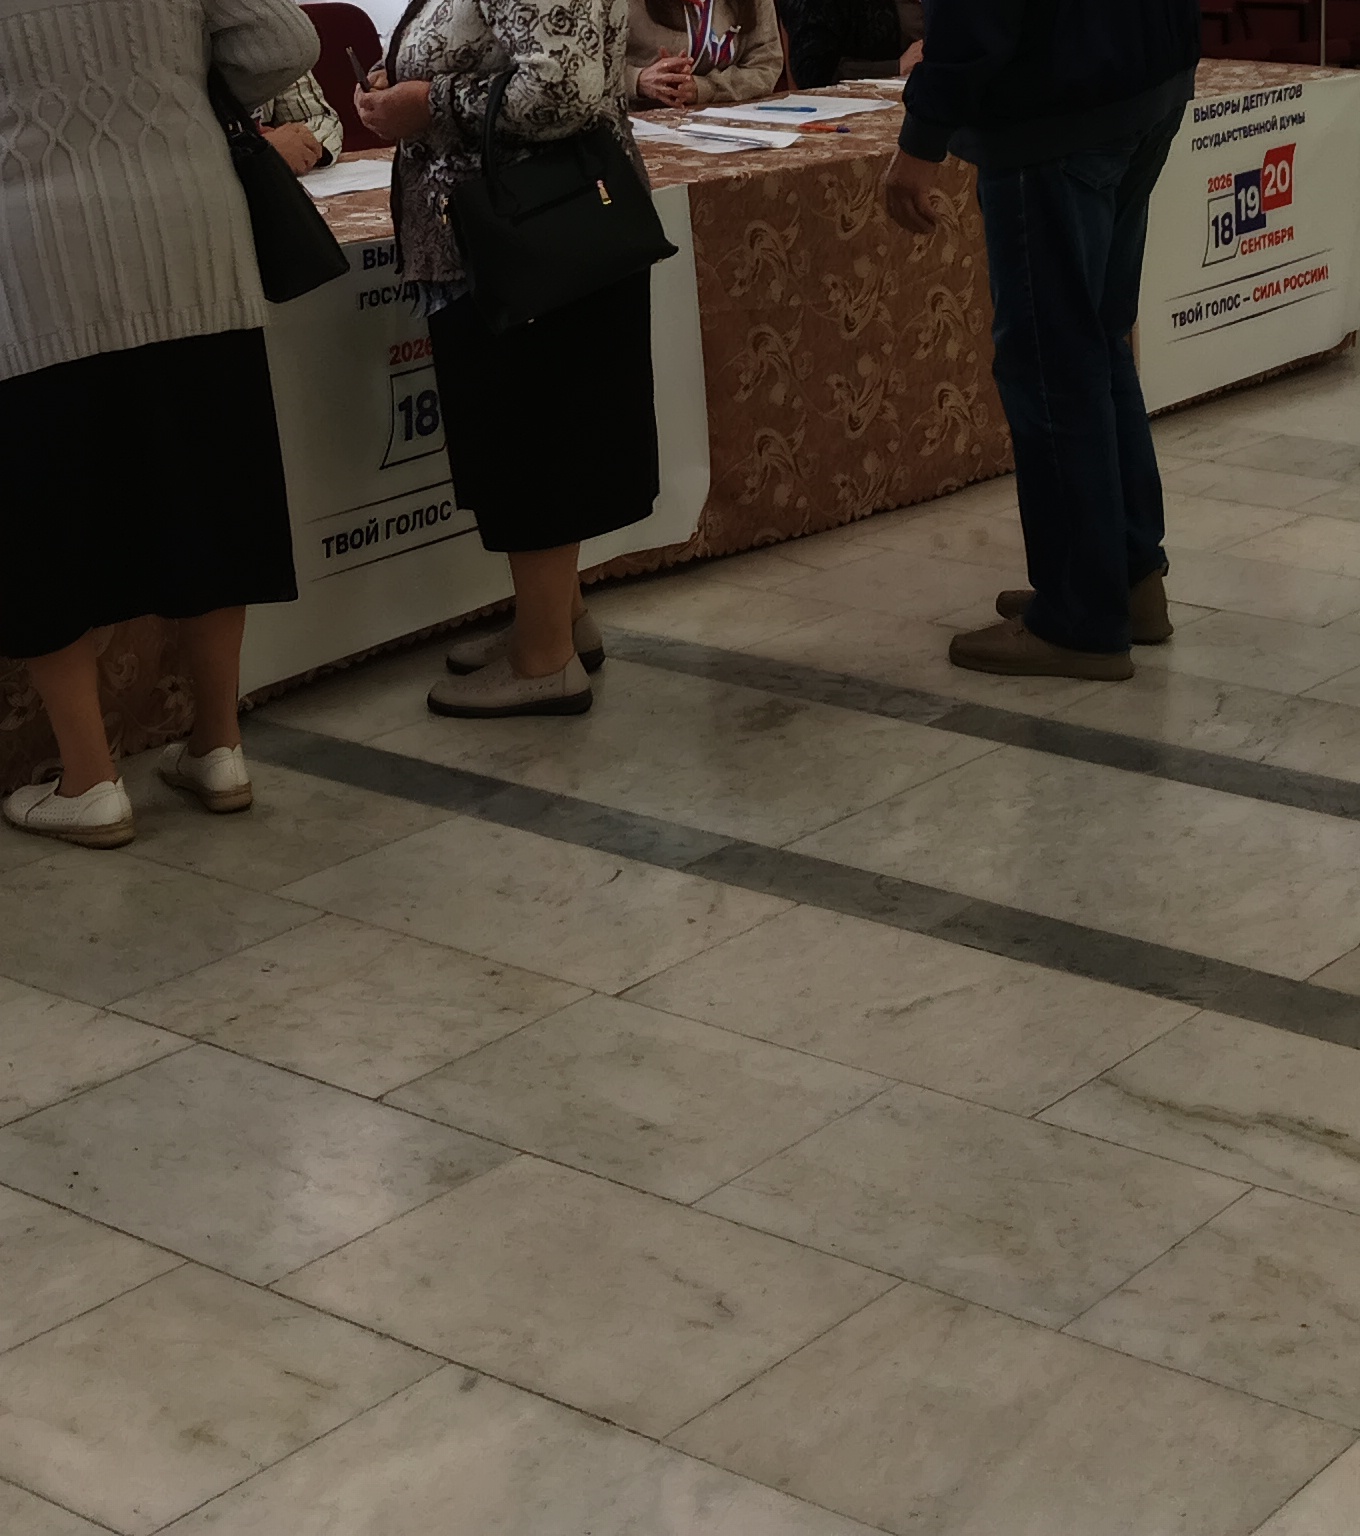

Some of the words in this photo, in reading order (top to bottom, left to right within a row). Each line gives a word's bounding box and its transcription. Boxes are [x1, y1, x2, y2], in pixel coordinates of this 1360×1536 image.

[1193, 98, 1241, 123] ВЫБОРЫ
[1242, 84, 1303, 113] ДЕПУТАТОВ
[1191, 116, 1279, 152] ГОСУДАРСТВЕННОЙ
[1279, 112, 1306, 133] ДУМЫ
[1207, 173, 1233, 193] 2026
[1211, 212, 1234, 248] 18
[1238, 187, 1260, 221] 19
[1264, 160, 1290, 197] 20
[1240, 226, 1294, 256] СЕНТЯБРЯ
[1171, 302, 1203, 329] ТВОЙ
[1205, 292, 1241, 319] ГОЛОС
[1252, 278, 1281, 303] СИЛА
[1283, 264, 1329, 294] РОССИИ!
[398, 390, 440, 441] 18
[321, 519, 380, 559] ТВОЙ
[385, 500, 452, 539] ГОЛОС
